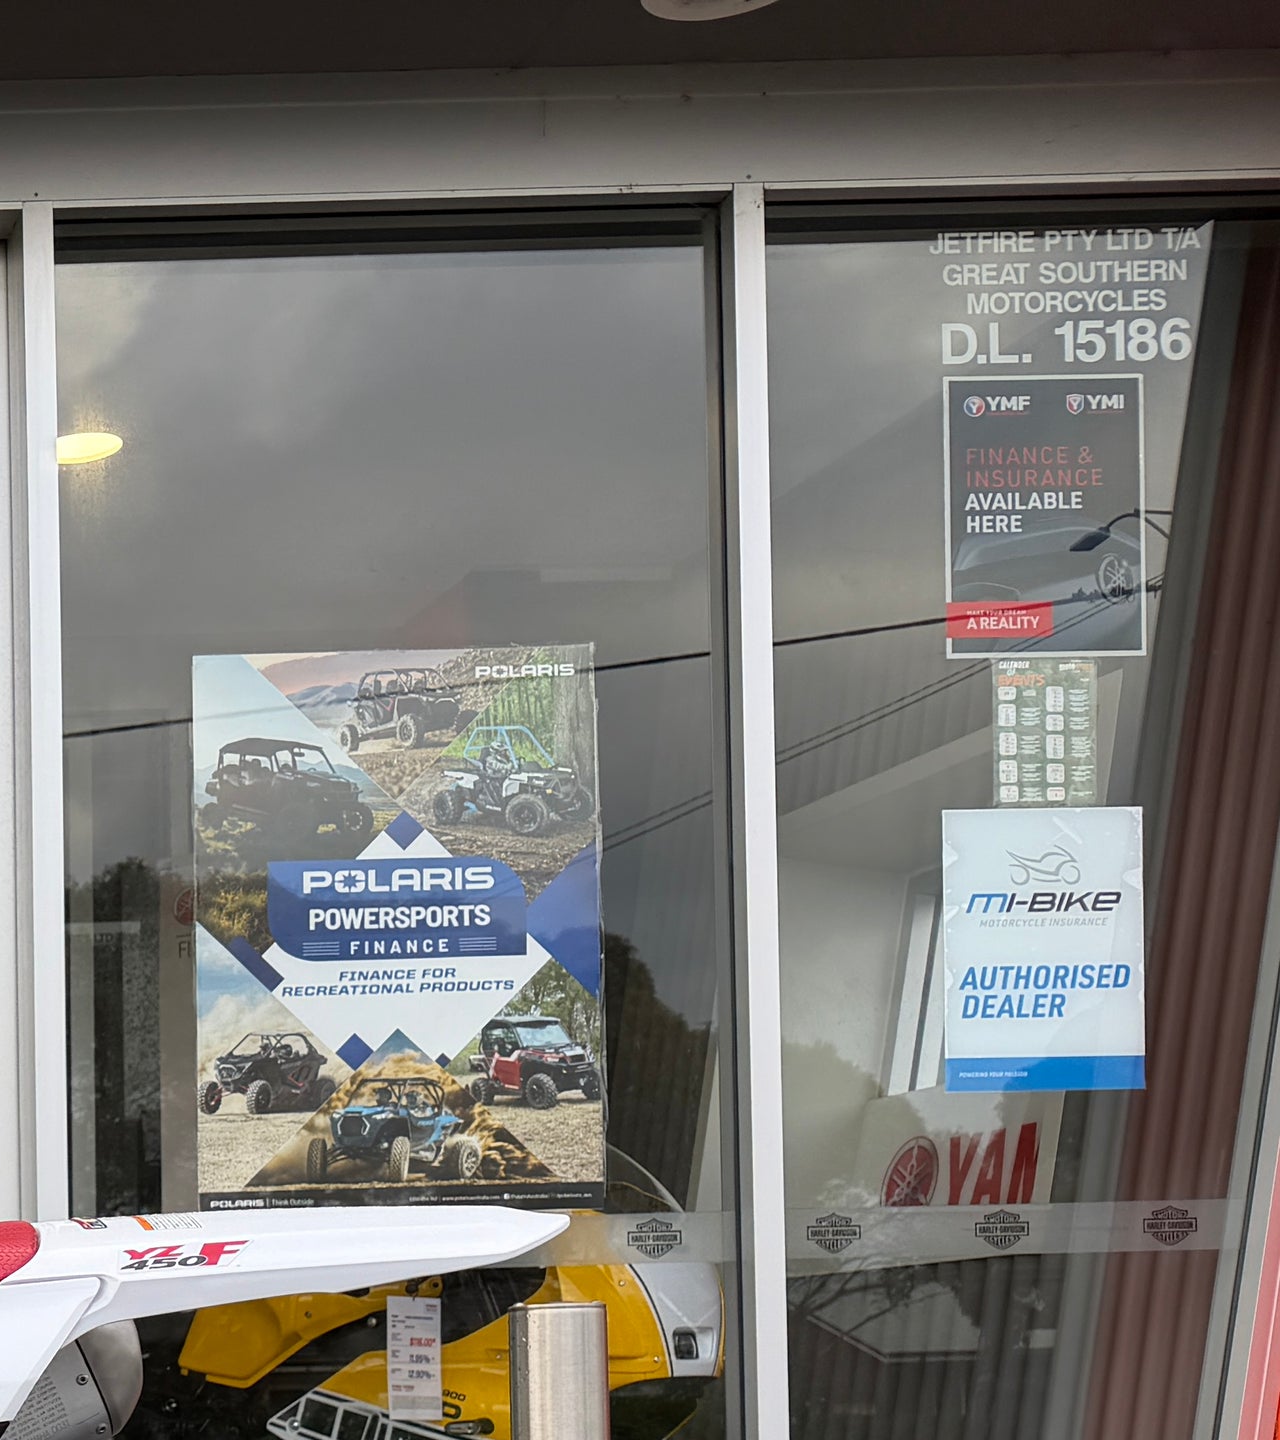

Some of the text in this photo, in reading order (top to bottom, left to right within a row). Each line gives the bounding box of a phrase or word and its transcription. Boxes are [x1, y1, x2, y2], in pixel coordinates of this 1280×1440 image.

[929, 227, 1201, 254] JETFIRE PTY LTD T/A
[942, 259, 1188, 286] GREAT SOUTHERN
[967, 289, 1167, 314] MOTORCYCLES
[941, 317, 1192, 365] D.L. 15186
[986, 396, 1031, 411] YMF
[1086, 394, 1125, 410] YMI
[966, 446, 1093, 465] FINANCE &
[967, 468, 1104, 488] INSURANCE
[965, 491, 1083, 511] AVAILABLE
[966, 515, 1023, 533] HERE
[966, 615, 1040, 629] A REALITY
[474, 663, 575, 679] POLARIS
[302, 866, 495, 894] POLARIS
[309, 904, 491, 931] POWERSPORTS
[979, 917, 1109, 928] MOTORCYCLE INSURANCE
[350, 939, 449, 954] FINANCE
[339, 967, 456, 982] FINANCE FOR
[959, 964, 1131, 991] AUTHORISED
[282, 979, 515, 997] RECREATIONAL PRODUCTS
[961, 993, 1066, 1019] DEALER
[210, 1199, 265, 1209] POLARIS
